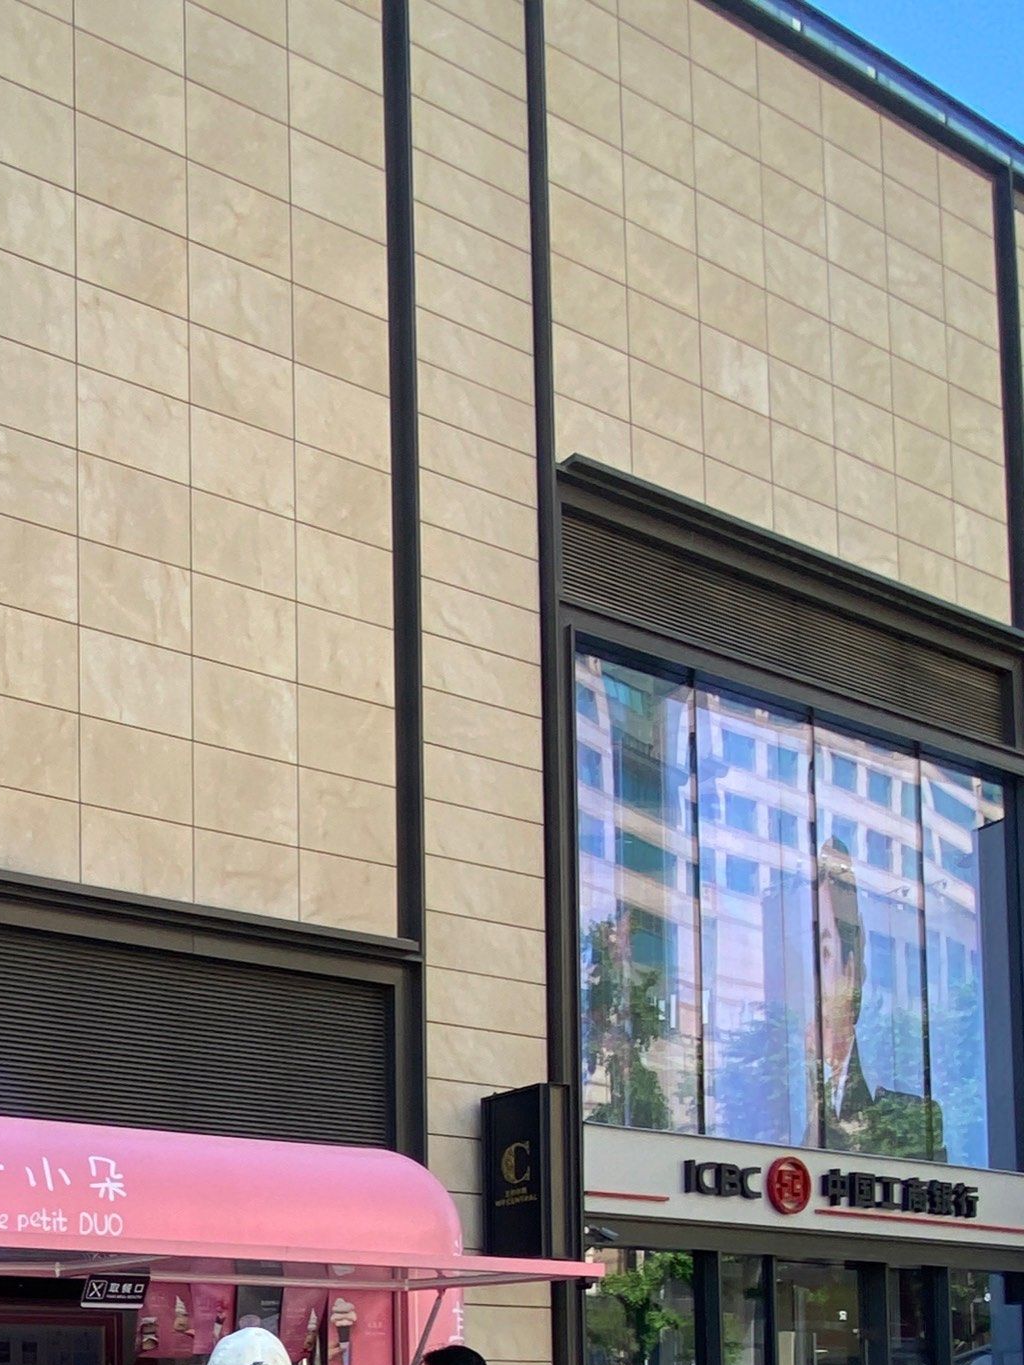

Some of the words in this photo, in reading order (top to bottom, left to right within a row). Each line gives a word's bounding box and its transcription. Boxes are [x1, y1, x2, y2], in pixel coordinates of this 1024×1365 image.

[684, 1159, 762, 1199] ICBC
[821, 1169, 979, 1218] 中国工商银行
[17, 1208, 68, 1232] petit
[79, 1211, 124, 1237] DUO
[108, 1282, 145, 1294] 取餐口
